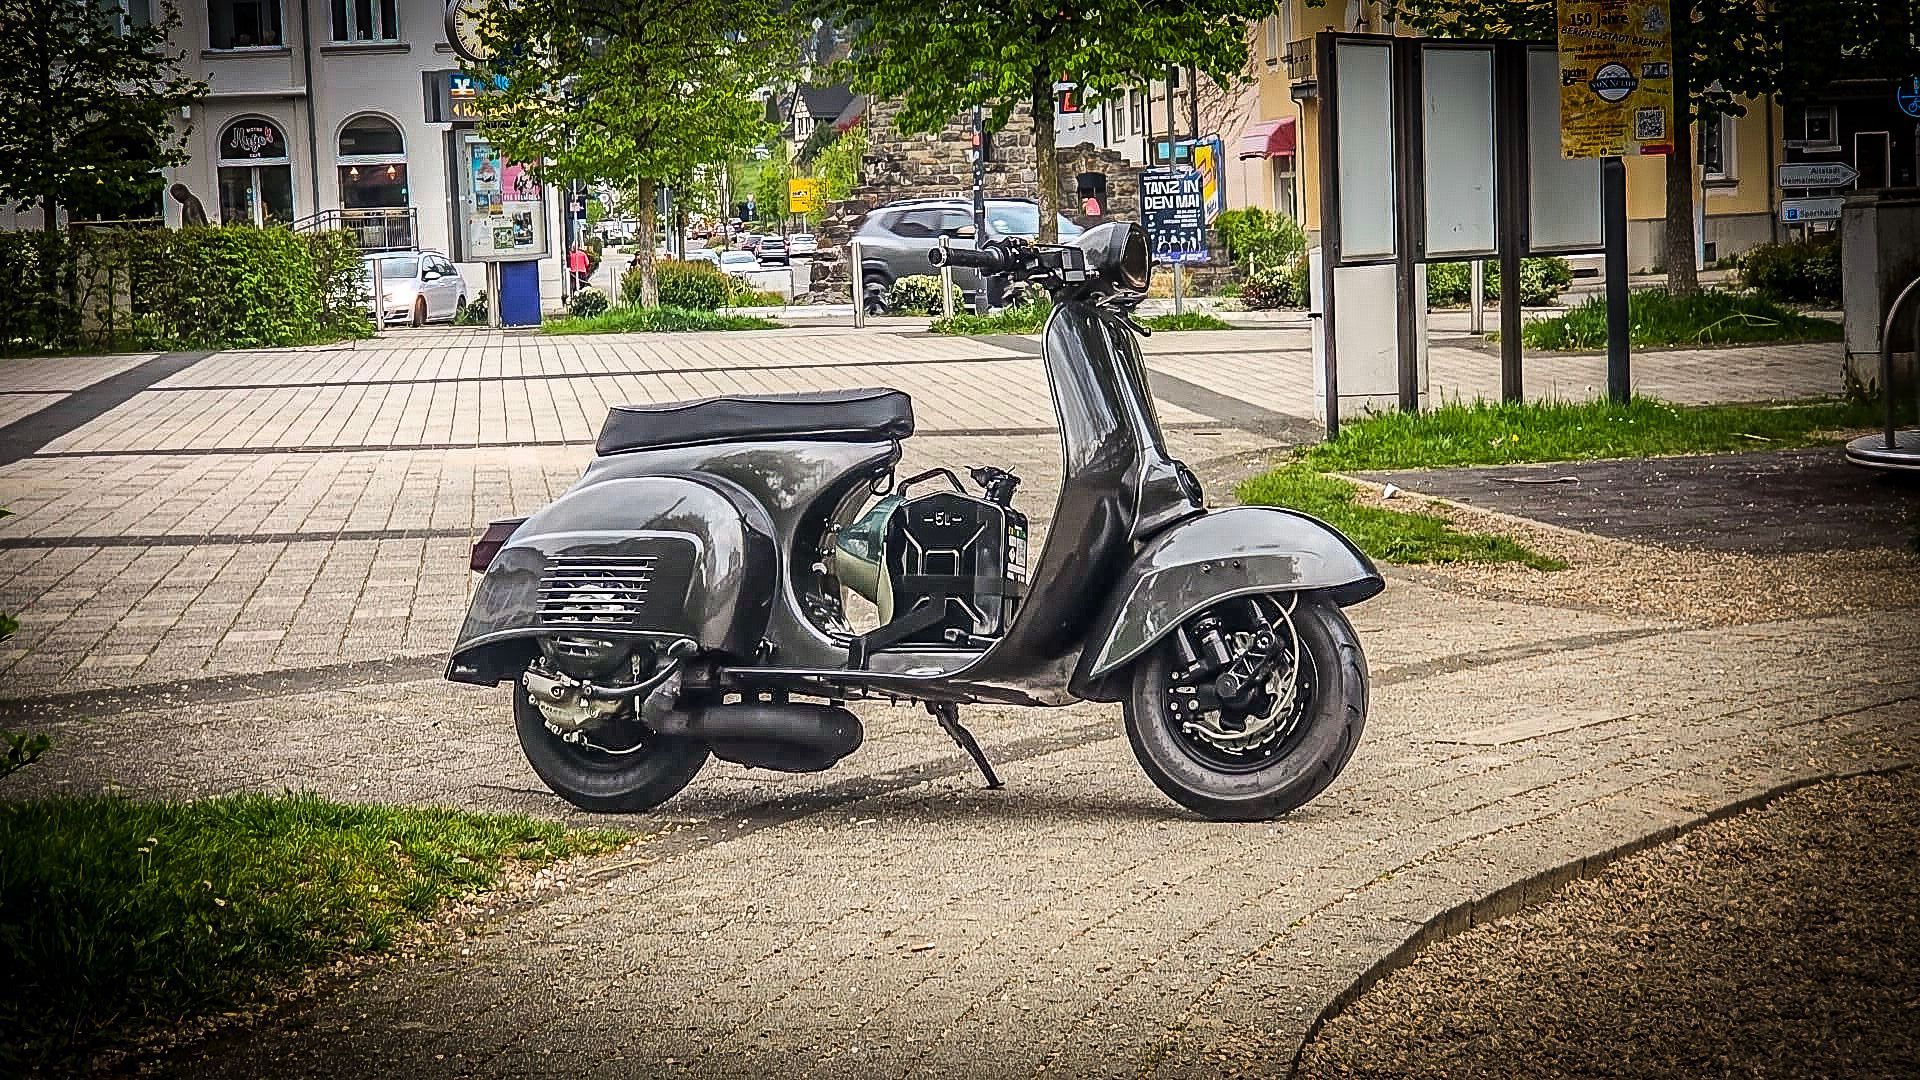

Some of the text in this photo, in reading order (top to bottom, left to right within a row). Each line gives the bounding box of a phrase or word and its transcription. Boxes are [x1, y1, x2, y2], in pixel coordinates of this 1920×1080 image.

[1570, 11, 1629, 28] 150 Jahre
[1562, 26, 1630, 44] BERGNEUSTADT
[1782, 174, 1841, 184] Heimatmuseum
[1811, 167, 1841, 175] Altstadt
[1143, 179, 1199, 195] TANZ IN
[1144, 195, 1174, 210] DEN
[1175, 194, 1199, 209] MAI
[1800, 208, 1839, 218] Sporthalle
